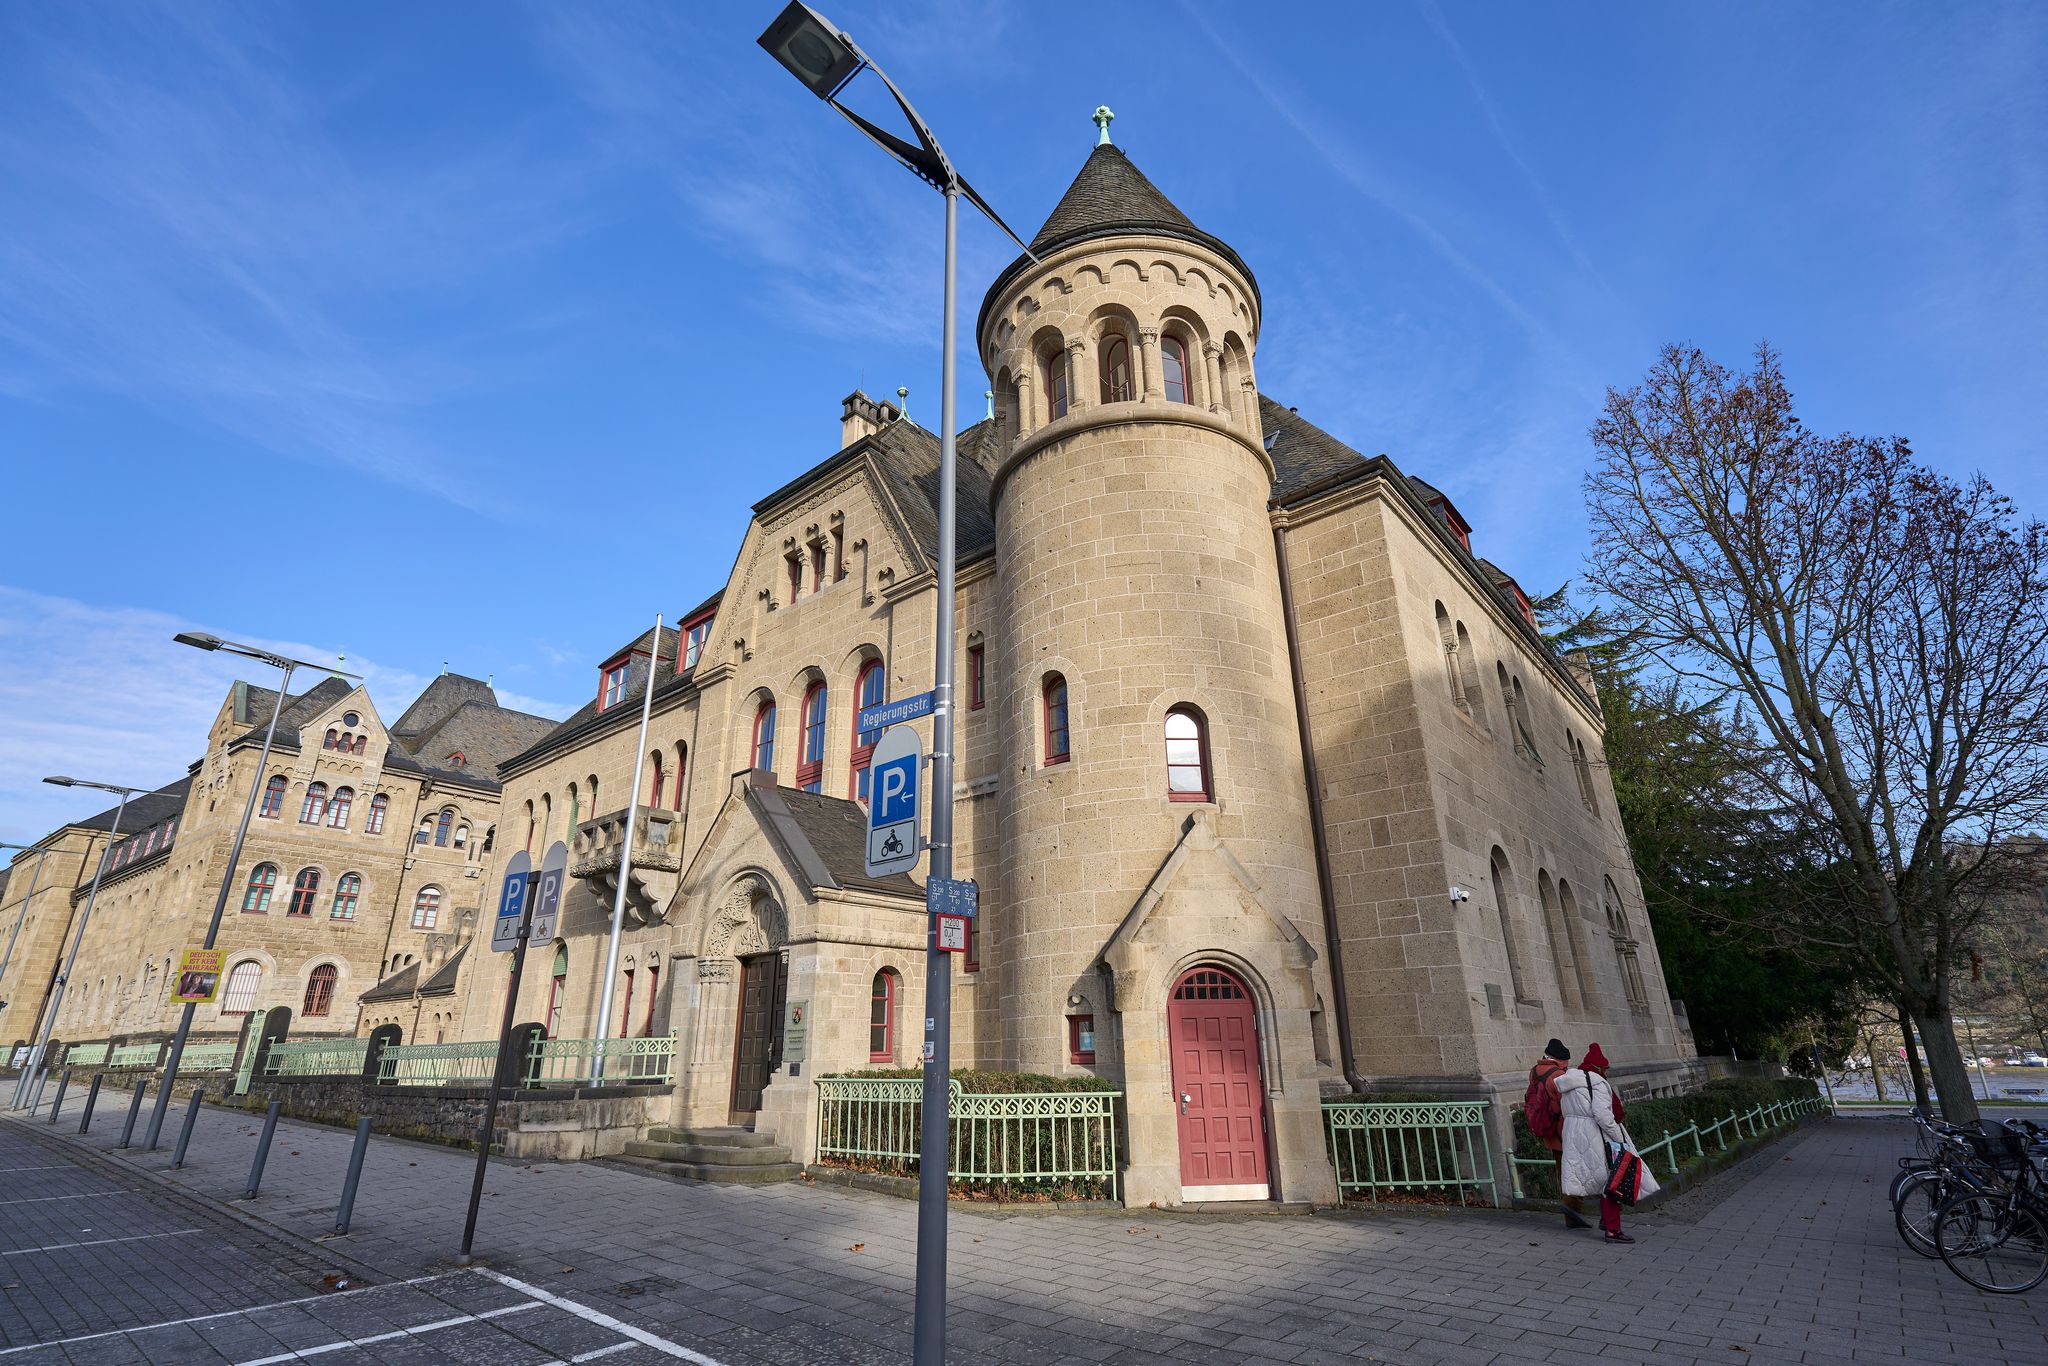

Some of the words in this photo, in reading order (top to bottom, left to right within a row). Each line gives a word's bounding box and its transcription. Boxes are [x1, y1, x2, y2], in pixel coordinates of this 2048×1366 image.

[863, 698, 929, 727] Regierungsstr.
[881, 766, 906, 817] P
[505, 878, 521, 912] P
[541, 876, 556, 910] P
